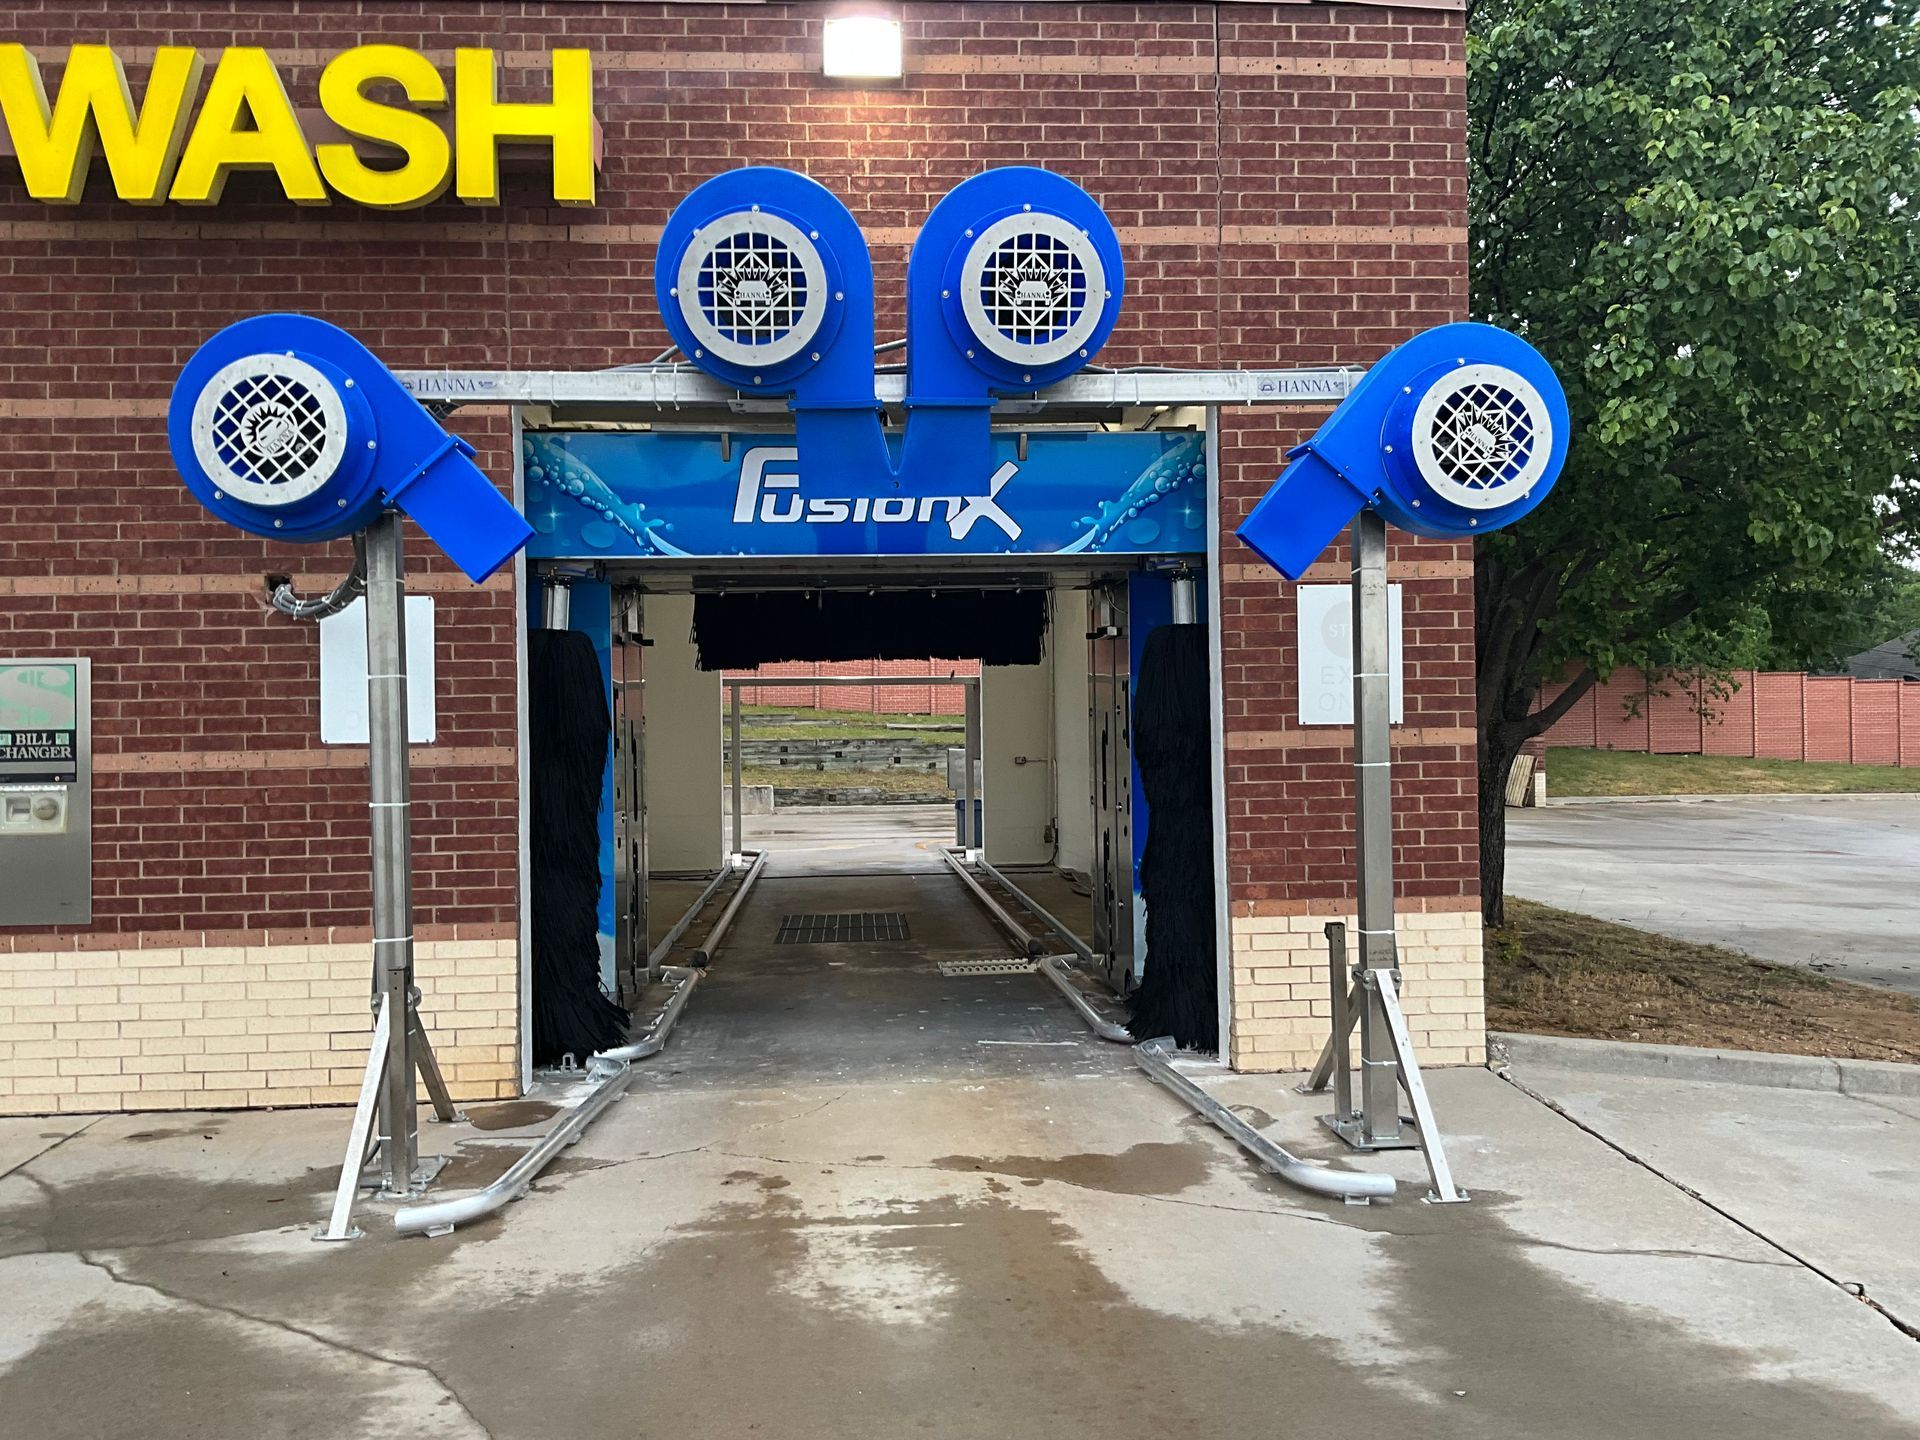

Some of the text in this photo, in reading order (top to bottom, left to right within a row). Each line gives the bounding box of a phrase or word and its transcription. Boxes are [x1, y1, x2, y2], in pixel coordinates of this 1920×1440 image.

[0, 43, 595, 207] WASH
[418, 378, 476, 392] HANNA
[1278, 379, 1332, 393] HANNA
[1320, 664, 1352, 685] EX
[15, 732, 53, 746] BILL
